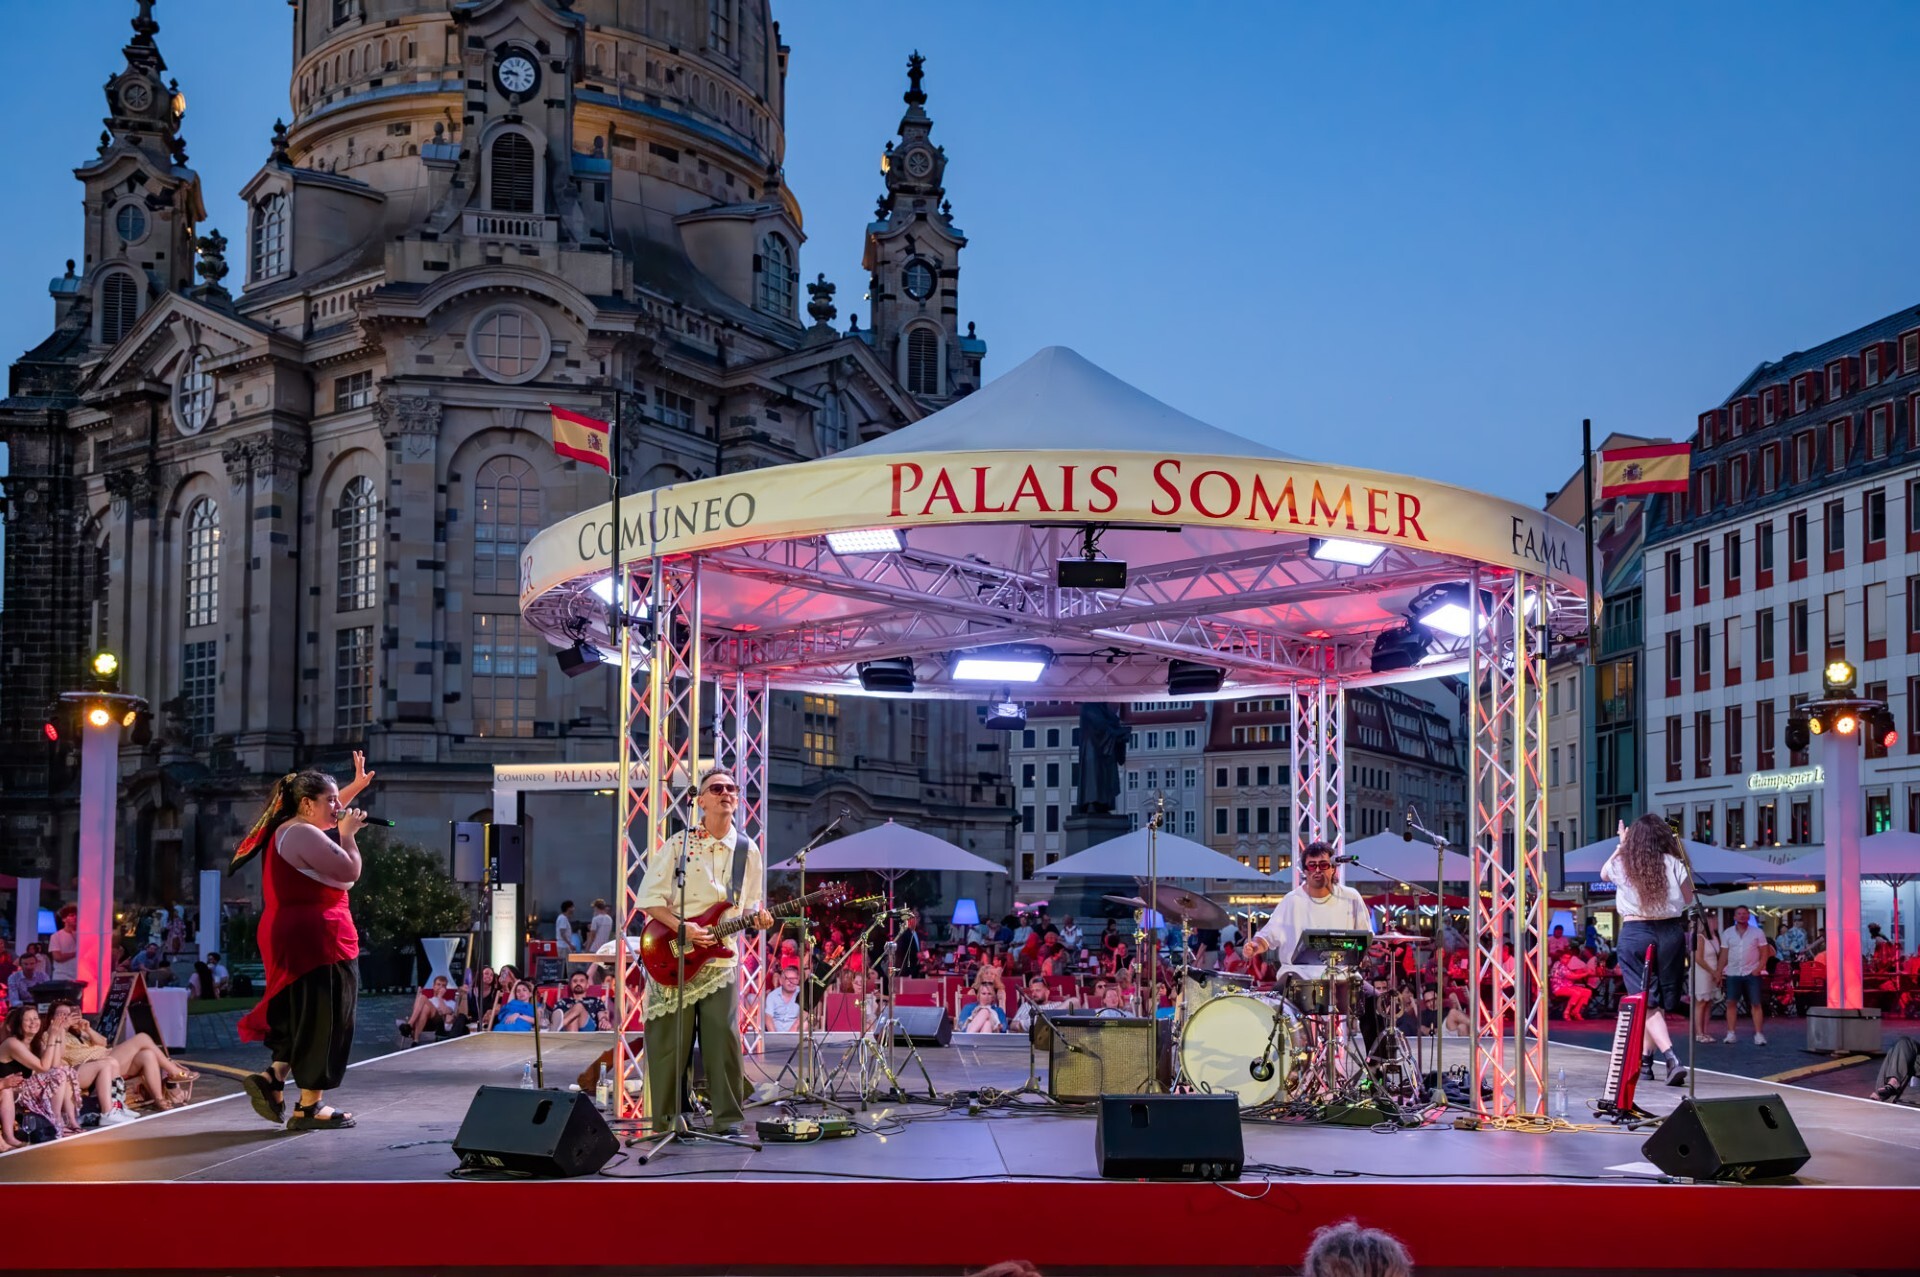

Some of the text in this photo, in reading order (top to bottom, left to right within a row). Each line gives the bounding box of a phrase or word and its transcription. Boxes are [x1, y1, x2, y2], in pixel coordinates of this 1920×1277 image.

[886, 459, 1429, 542] PALAIS SOMMER
[578, 493, 756, 561] COMUNEO
[1511, 515, 1571, 575] FAMA
[497, 773, 546, 782] COMUNEO
[554, 769, 601, 783] PALAIS
[1747, 773, 1812, 789] Champagner
